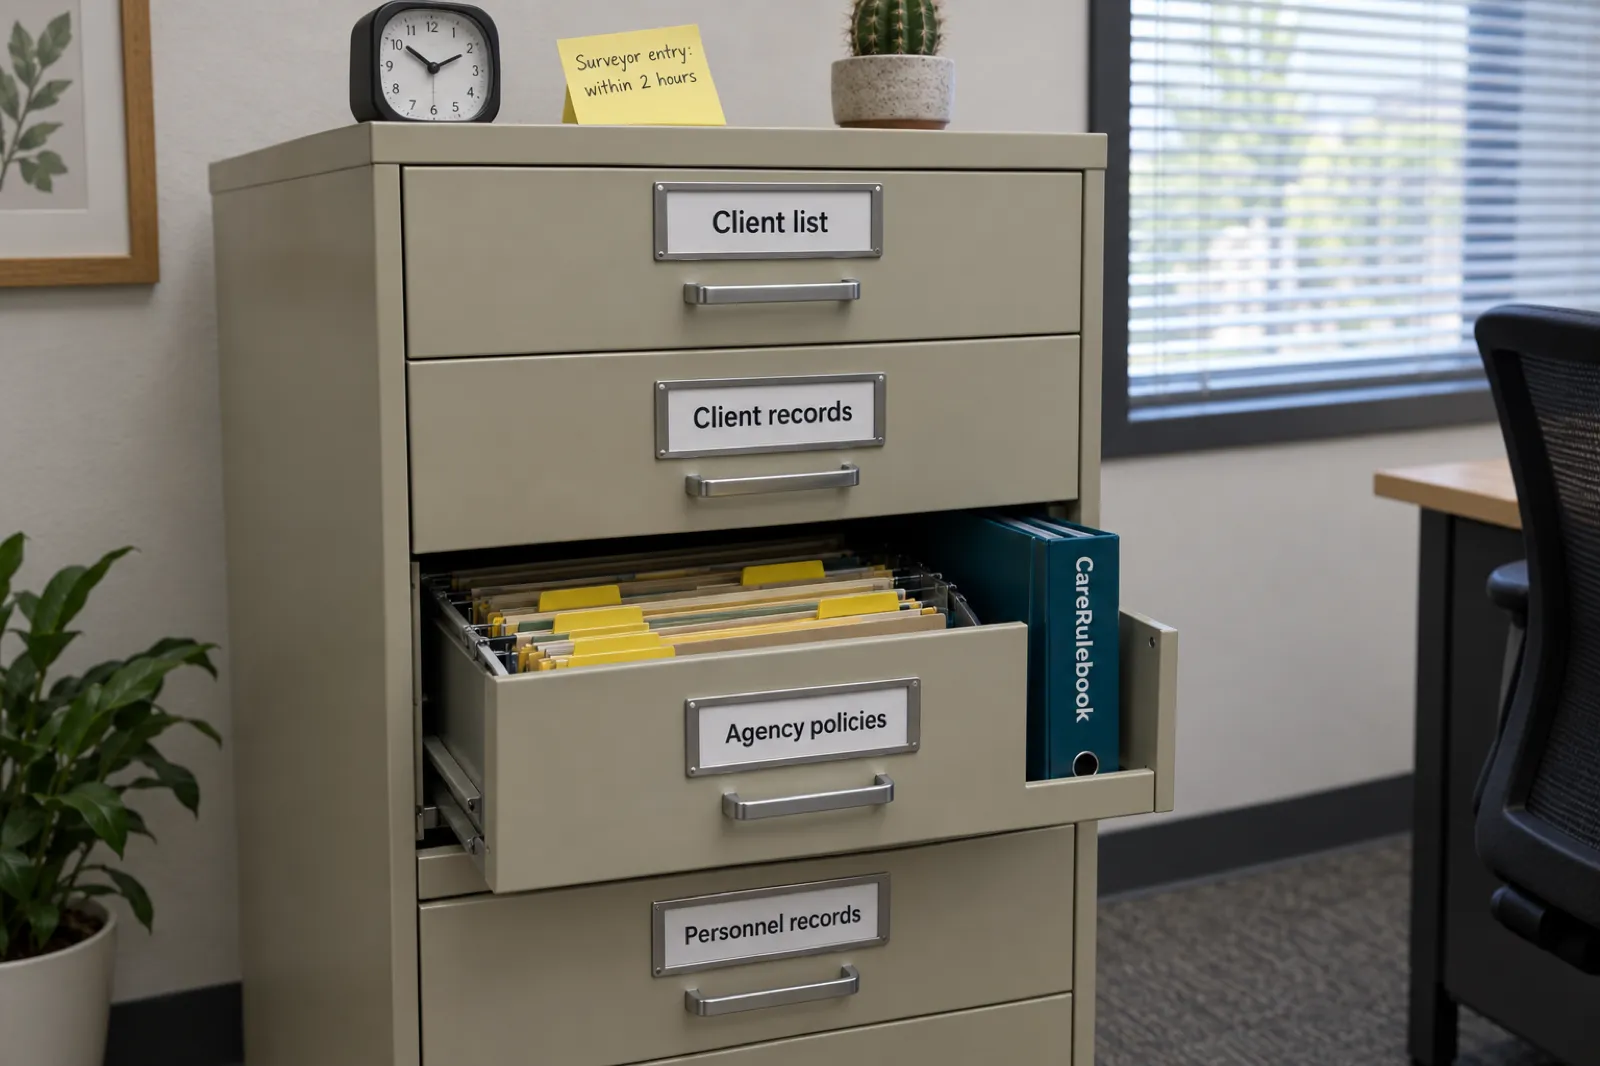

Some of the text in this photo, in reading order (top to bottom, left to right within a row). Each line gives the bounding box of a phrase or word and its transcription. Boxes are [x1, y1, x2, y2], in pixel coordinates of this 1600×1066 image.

[406, 24, 416, 36] 11
[426, 21, 439, 33] 12
[390, 39, 403, 51] 10
[466, 43, 473, 54] 2
[576, 44, 693, 72] Surveyor entry:
[386, 61, 393, 72] 9
[472, 65, 479, 76] 3
[392, 83, 400, 94] 8
[584, 72, 697, 97] within 2 hours
[467, 87, 474, 98] 4
[409, 100, 416, 110] 7
[430, 105, 438, 115] 6
[452, 102, 459, 112] 5
[712, 210, 828, 233] Client list
[694, 401, 853, 429] Client records
[1076, 557, 1094, 723] CareRulebook
[726, 711, 887, 747] Agency policies
[685, 905, 861, 945] Personnel records
